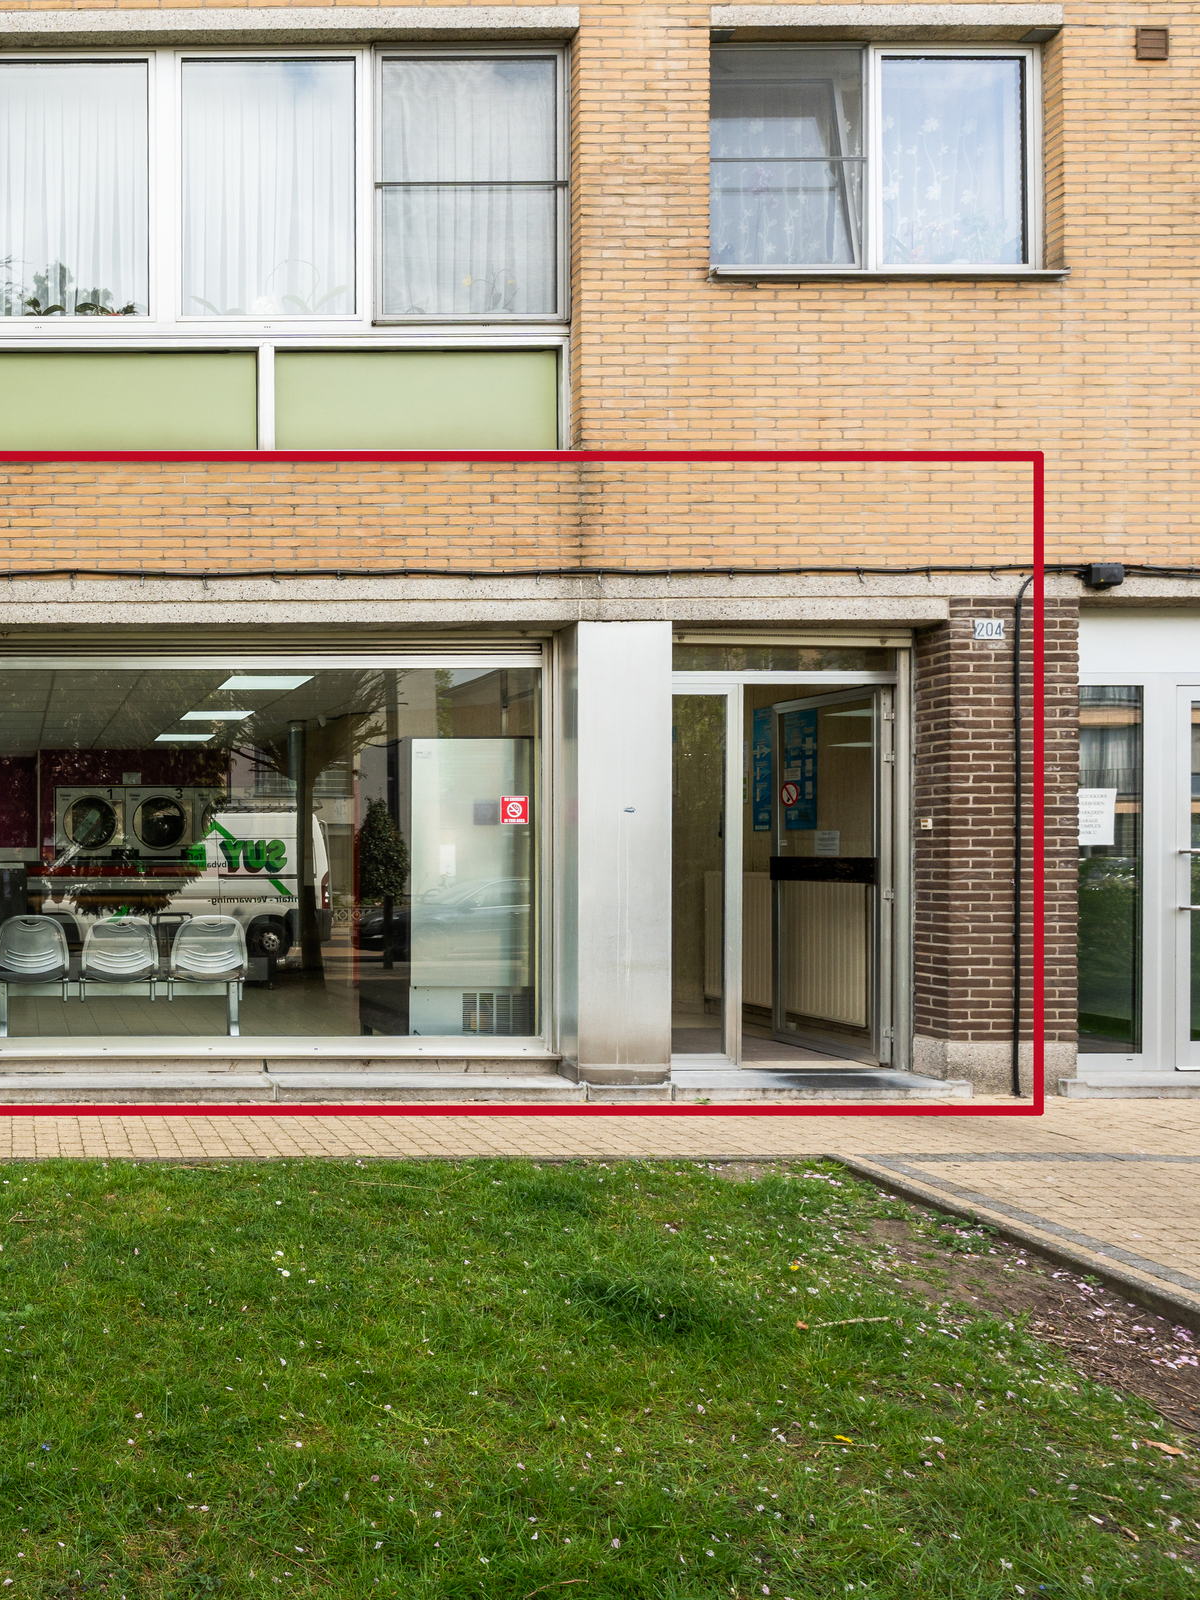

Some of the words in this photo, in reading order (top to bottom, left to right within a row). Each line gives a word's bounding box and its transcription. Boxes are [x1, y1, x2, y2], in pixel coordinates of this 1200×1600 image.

[976, 622, 1002, 637] 204
[106, 788, 112, 800] 1
[174, 788, 183, 799] 3
[244, 788, 252, 798] 5
